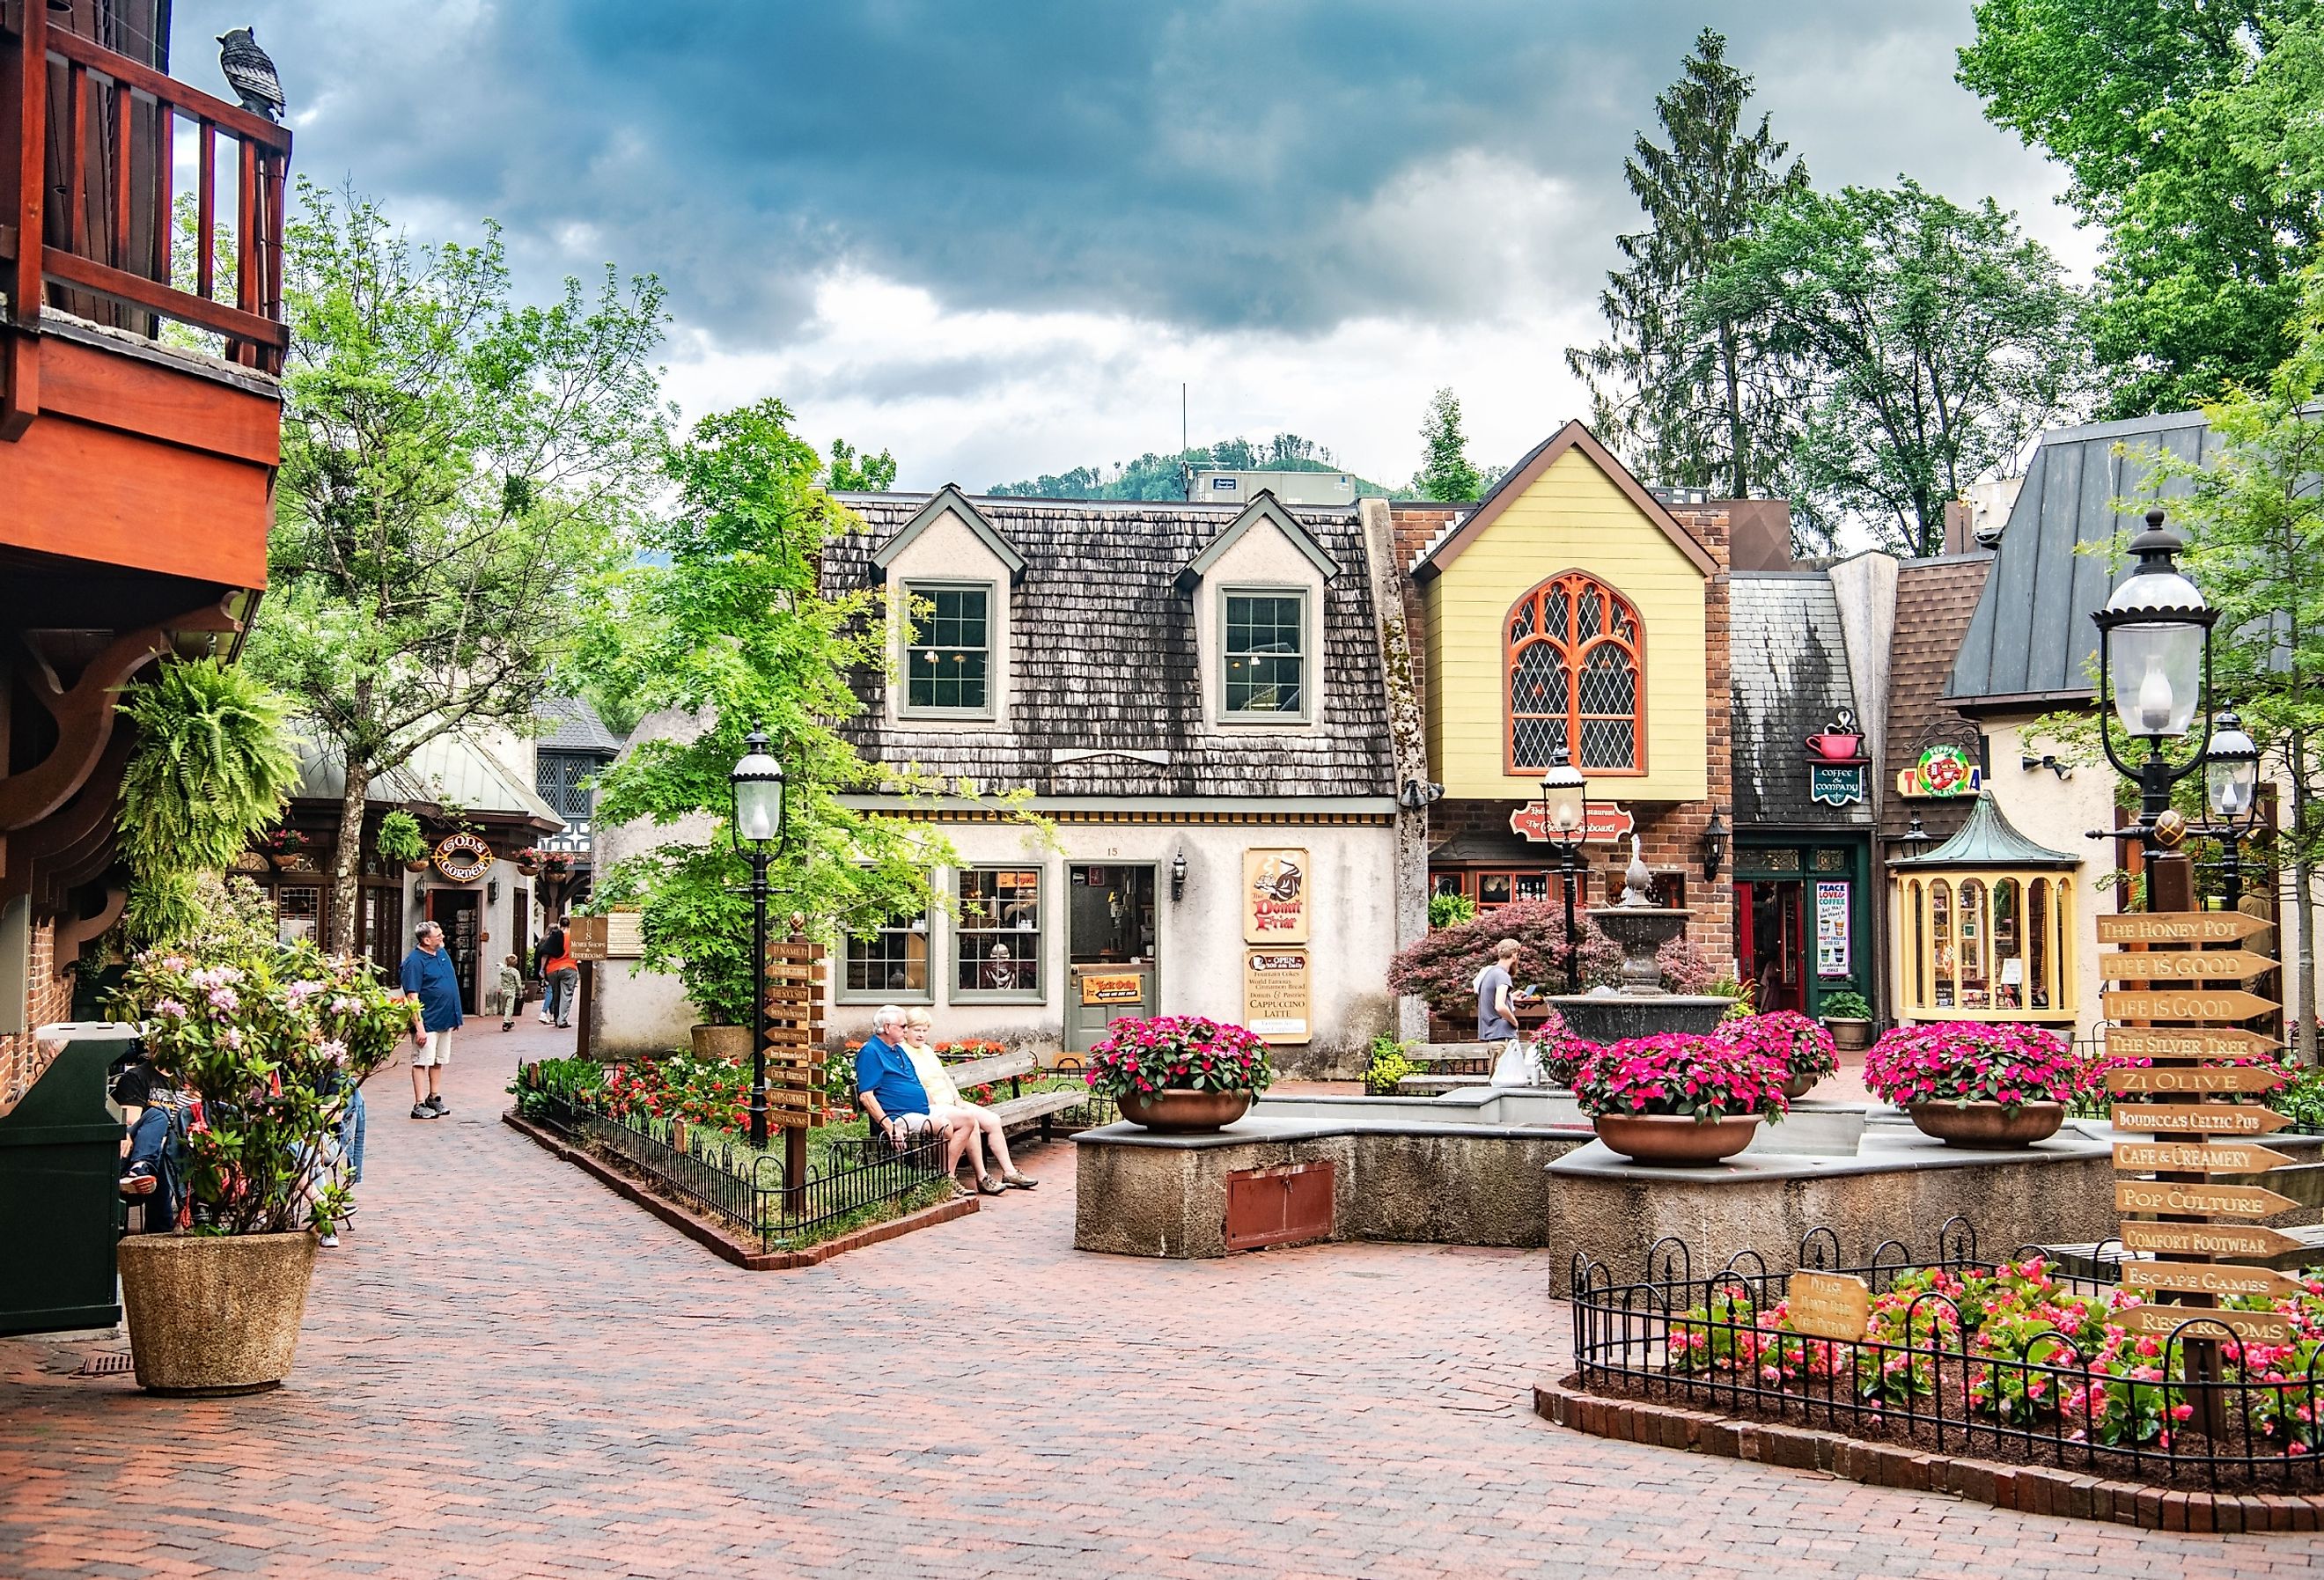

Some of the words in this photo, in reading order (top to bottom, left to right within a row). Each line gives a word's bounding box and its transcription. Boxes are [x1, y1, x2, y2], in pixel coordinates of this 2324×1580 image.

[443, 835, 486, 853] GODS
[441, 861, 486, 878] CORNER
[1254, 899, 1303, 915] Donut
[1254, 915, 1297, 931] Friar
[2101, 922, 2134, 938] THE
[2139, 920, 2200, 937] HONEY
[2203, 920, 2239, 937] POT
[2105, 958, 2147, 974] LIFE
[2154, 958, 2171, 974] IS
[2175, 957, 2240, 974] GOOD
[2109, 997, 2148, 1018] LIFE
[2154, 999, 2169, 1017] IS
[2173, 996, 2233, 1017] GOOD
[2110, 1035, 2144, 1053] THE
[2146, 1036, 2203, 1054] SILVER
[2205, 1038, 2248, 1055] TREE
[2122, 1073, 2147, 1090] ZI
[2156, 1073, 2238, 1090] OLIVE
[771, 1112, 808, 1125] RESTROOMS
[2119, 1110, 2188, 1128] BOUDICCA'S
[2189, 1112, 2232, 1129] CELTIC
[2235, 1113, 2260, 1129] PUB
[2119, 1145, 2156, 1164] CAFE
[2159, 1153, 2170, 1163] &
[2171, 1147, 2252, 1167] CREAMERY
[2123, 1188, 2164, 1207] POP
[2167, 1191, 2265, 1213] CULTURE
[2127, 1231, 2189, 1250] COMFORT
[2193, 1233, 2268, 1253] FOOTWEAR
[2128, 1268, 2198, 1288] ESCAPE
[2202, 1272, 2269, 1292] GAMES
[2141, 1312, 2284, 1340] RESTROOMS
